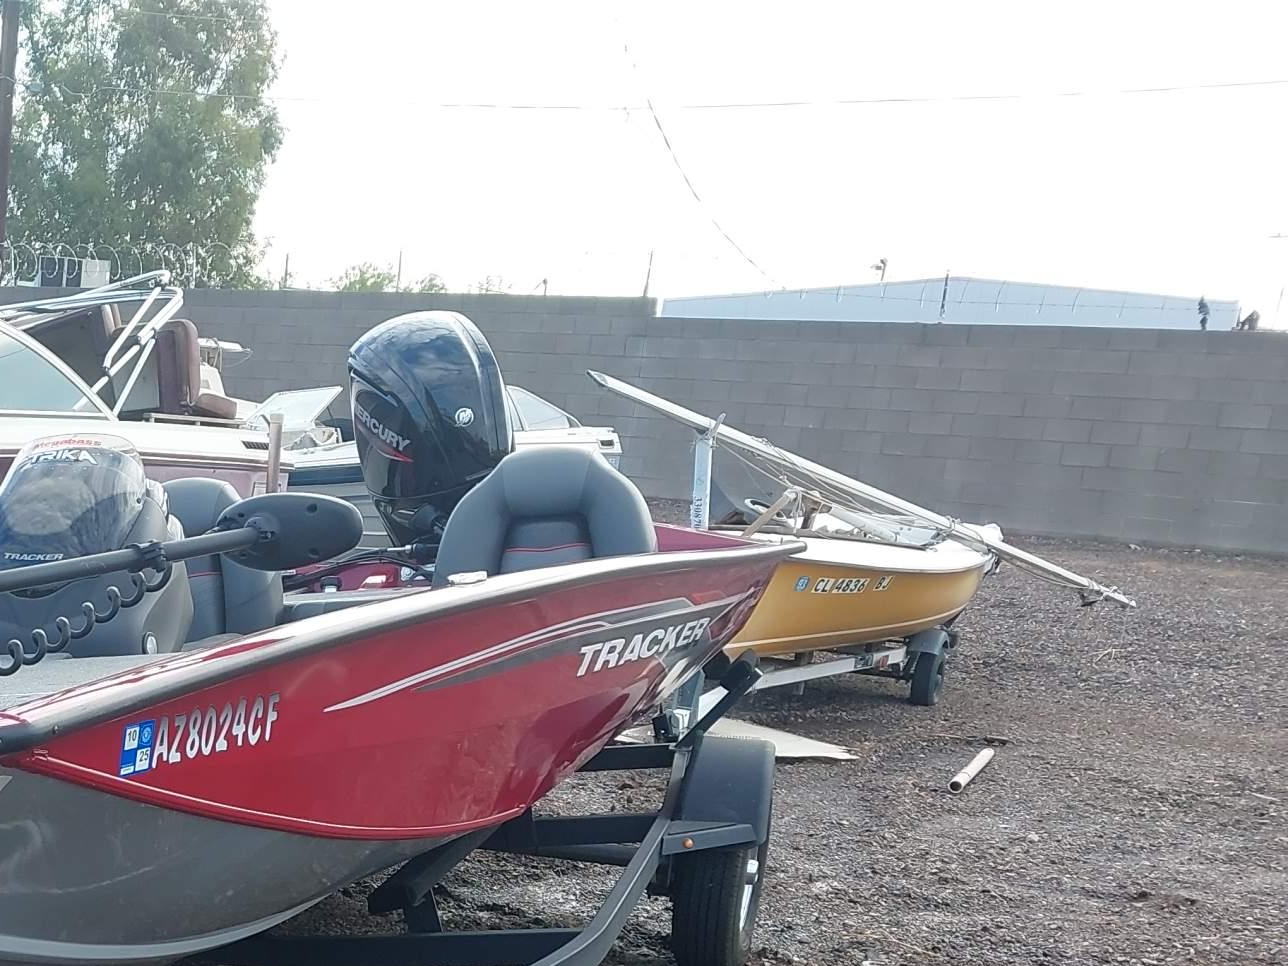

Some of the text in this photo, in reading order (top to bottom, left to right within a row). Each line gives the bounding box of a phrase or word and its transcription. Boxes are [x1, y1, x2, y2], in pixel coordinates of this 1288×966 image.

[3, 552, 64, 561] TRACKER
[813, 578, 831, 592] CL
[576, 617, 711, 677] TRACKER
[127, 729, 138, 742] 10
[139, 749, 149, 762] 25
